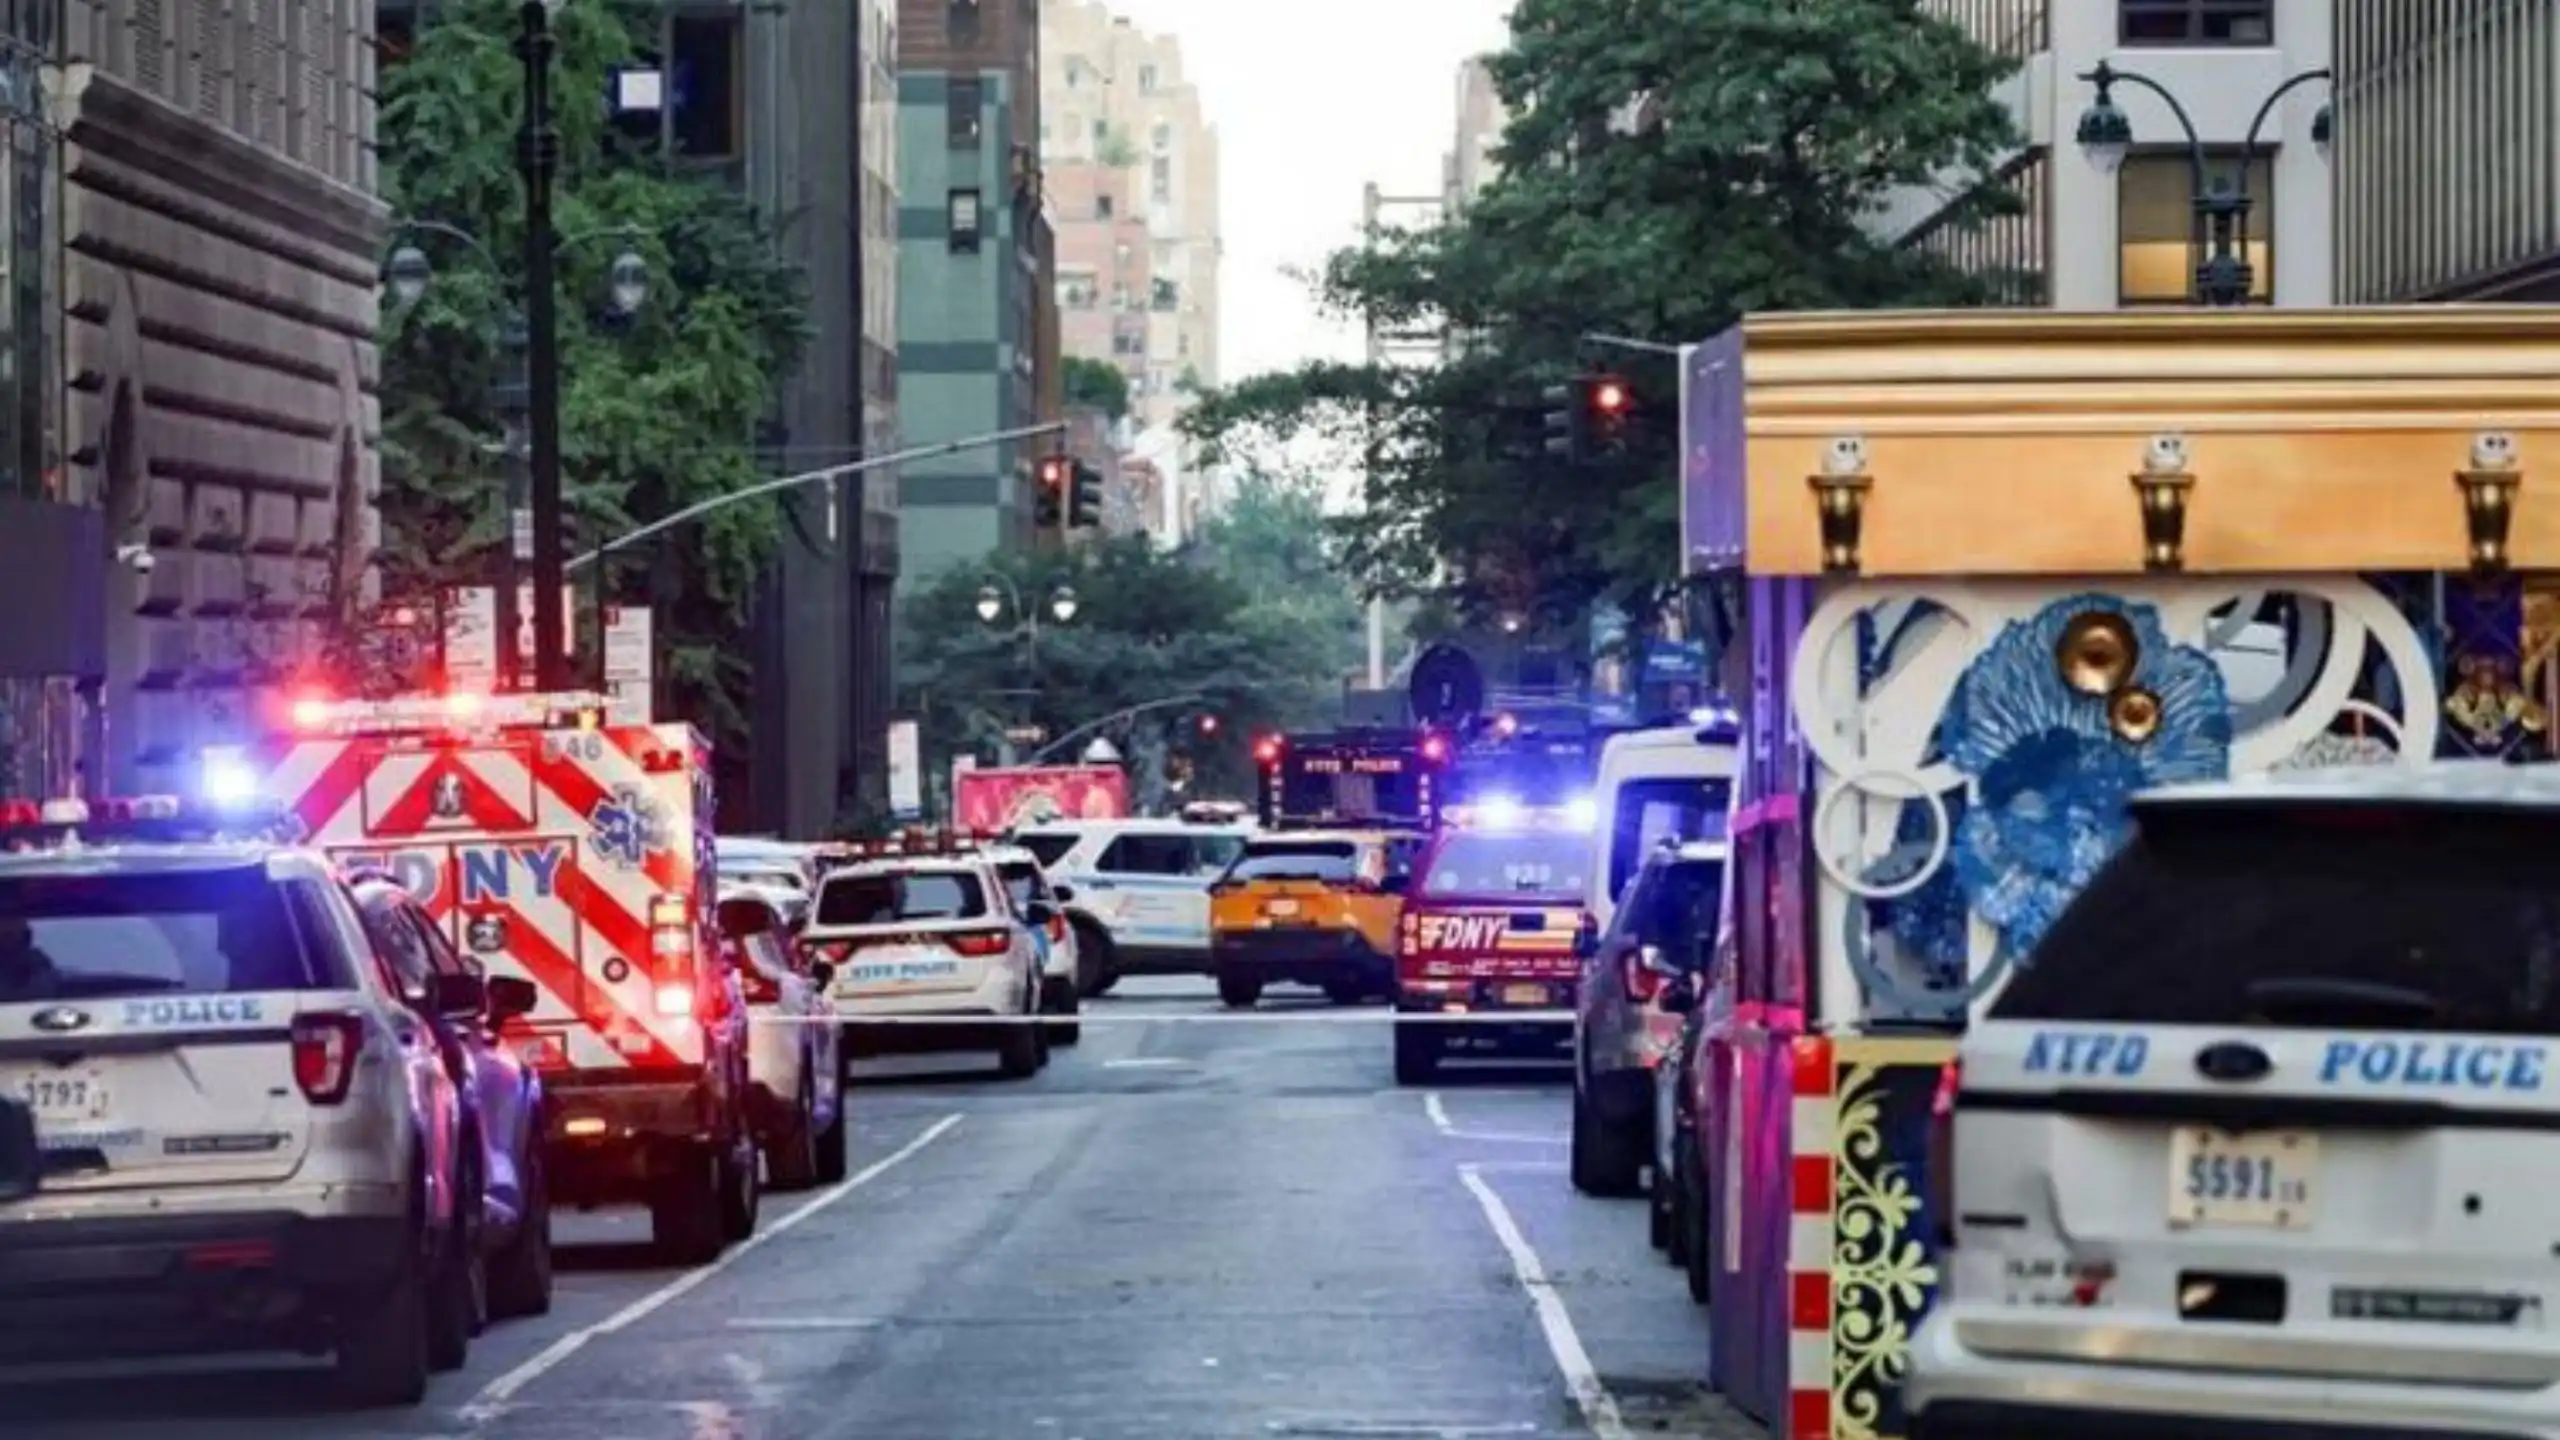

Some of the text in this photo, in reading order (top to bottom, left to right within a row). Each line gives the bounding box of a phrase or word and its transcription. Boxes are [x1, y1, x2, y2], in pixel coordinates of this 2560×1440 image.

[1424, 915, 1500, 950] FDNY
[122, 997, 263, 1026] POLICE
[2023, 1030, 2547, 1091] NYPD POLICE
[2184, 1153, 2273, 1202] 5591
